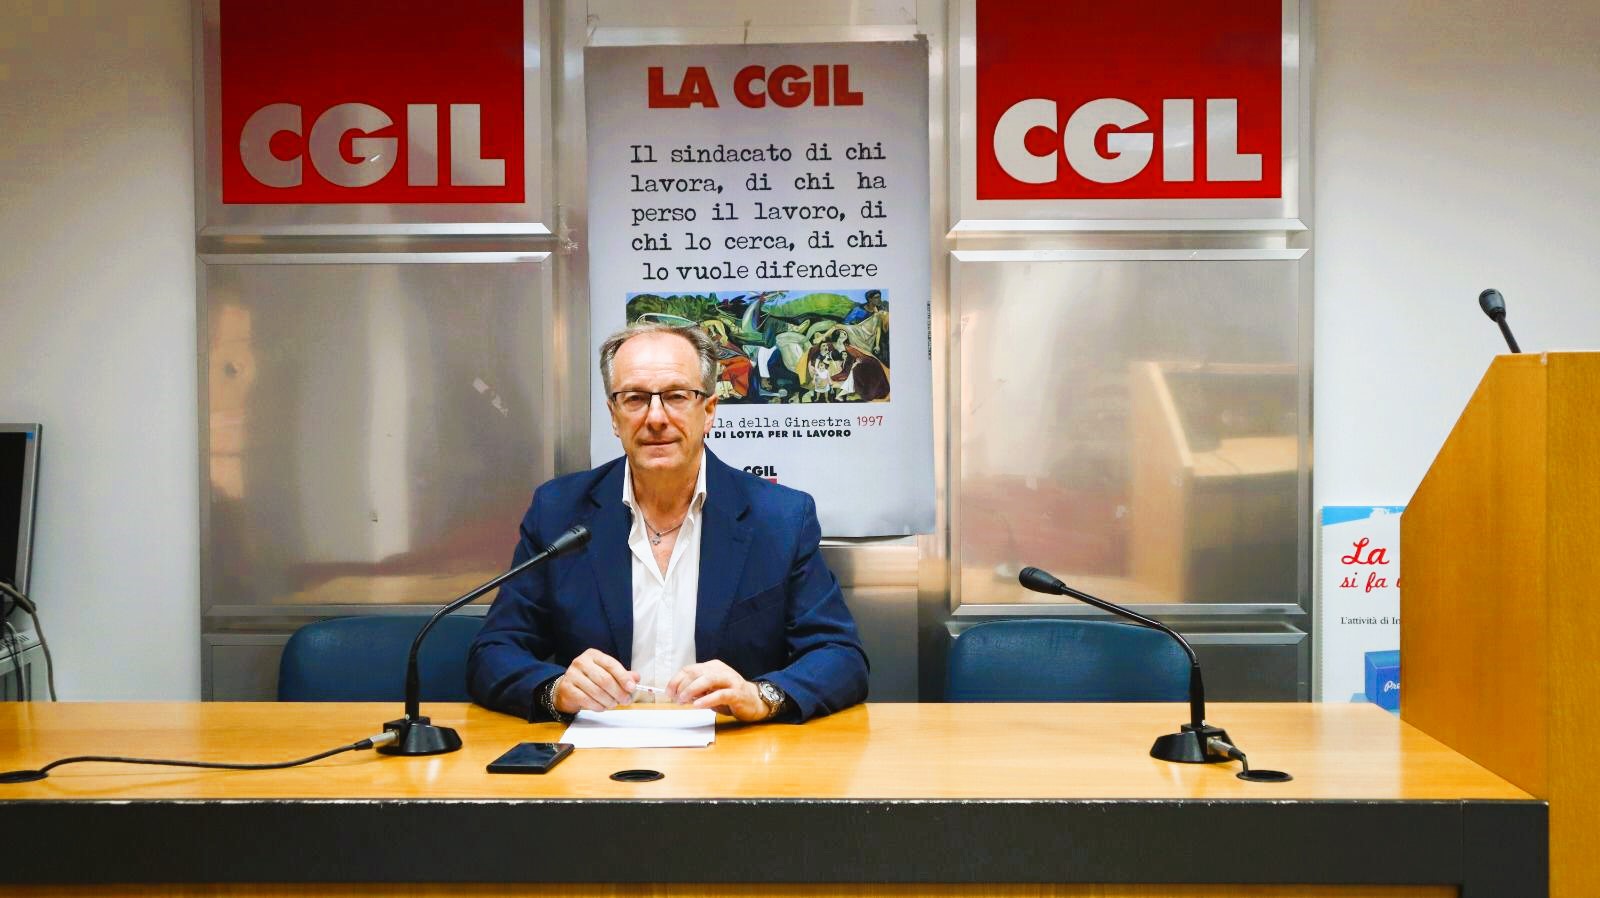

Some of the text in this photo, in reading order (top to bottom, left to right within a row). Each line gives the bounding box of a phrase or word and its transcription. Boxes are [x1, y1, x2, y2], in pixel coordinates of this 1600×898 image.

[647, 64, 864, 108] LA CGIL
[239, 103, 506, 188] CGIL
[993, 97, 1263, 184] CGIL
[629, 141, 887, 163] Il sindacato di chi
[630, 172, 887, 194] lavora, di chi ha
[631, 200, 887, 226] perso il lavoro, di
[631, 230, 887, 252] chi lo cerca, di chi
[642, 260, 878, 281] lo vuole difendere
[738, 417, 780, 429] della
[784, 416, 852, 428] Ginestra
[856, 415, 884, 427] 1997
[714, 430, 727, 439] DI
[730, 430, 765, 439] LOTTA
[768, 430, 789, 438] PER
[792, 429, 803, 438] IL
[806, 429, 852, 438] LAVORO
[1341, 537, 1390, 566] La
[1339, 572, 1358, 589] si
[1365, 571, 1388, 593] fa
[1380, 616, 1389, 625] di
